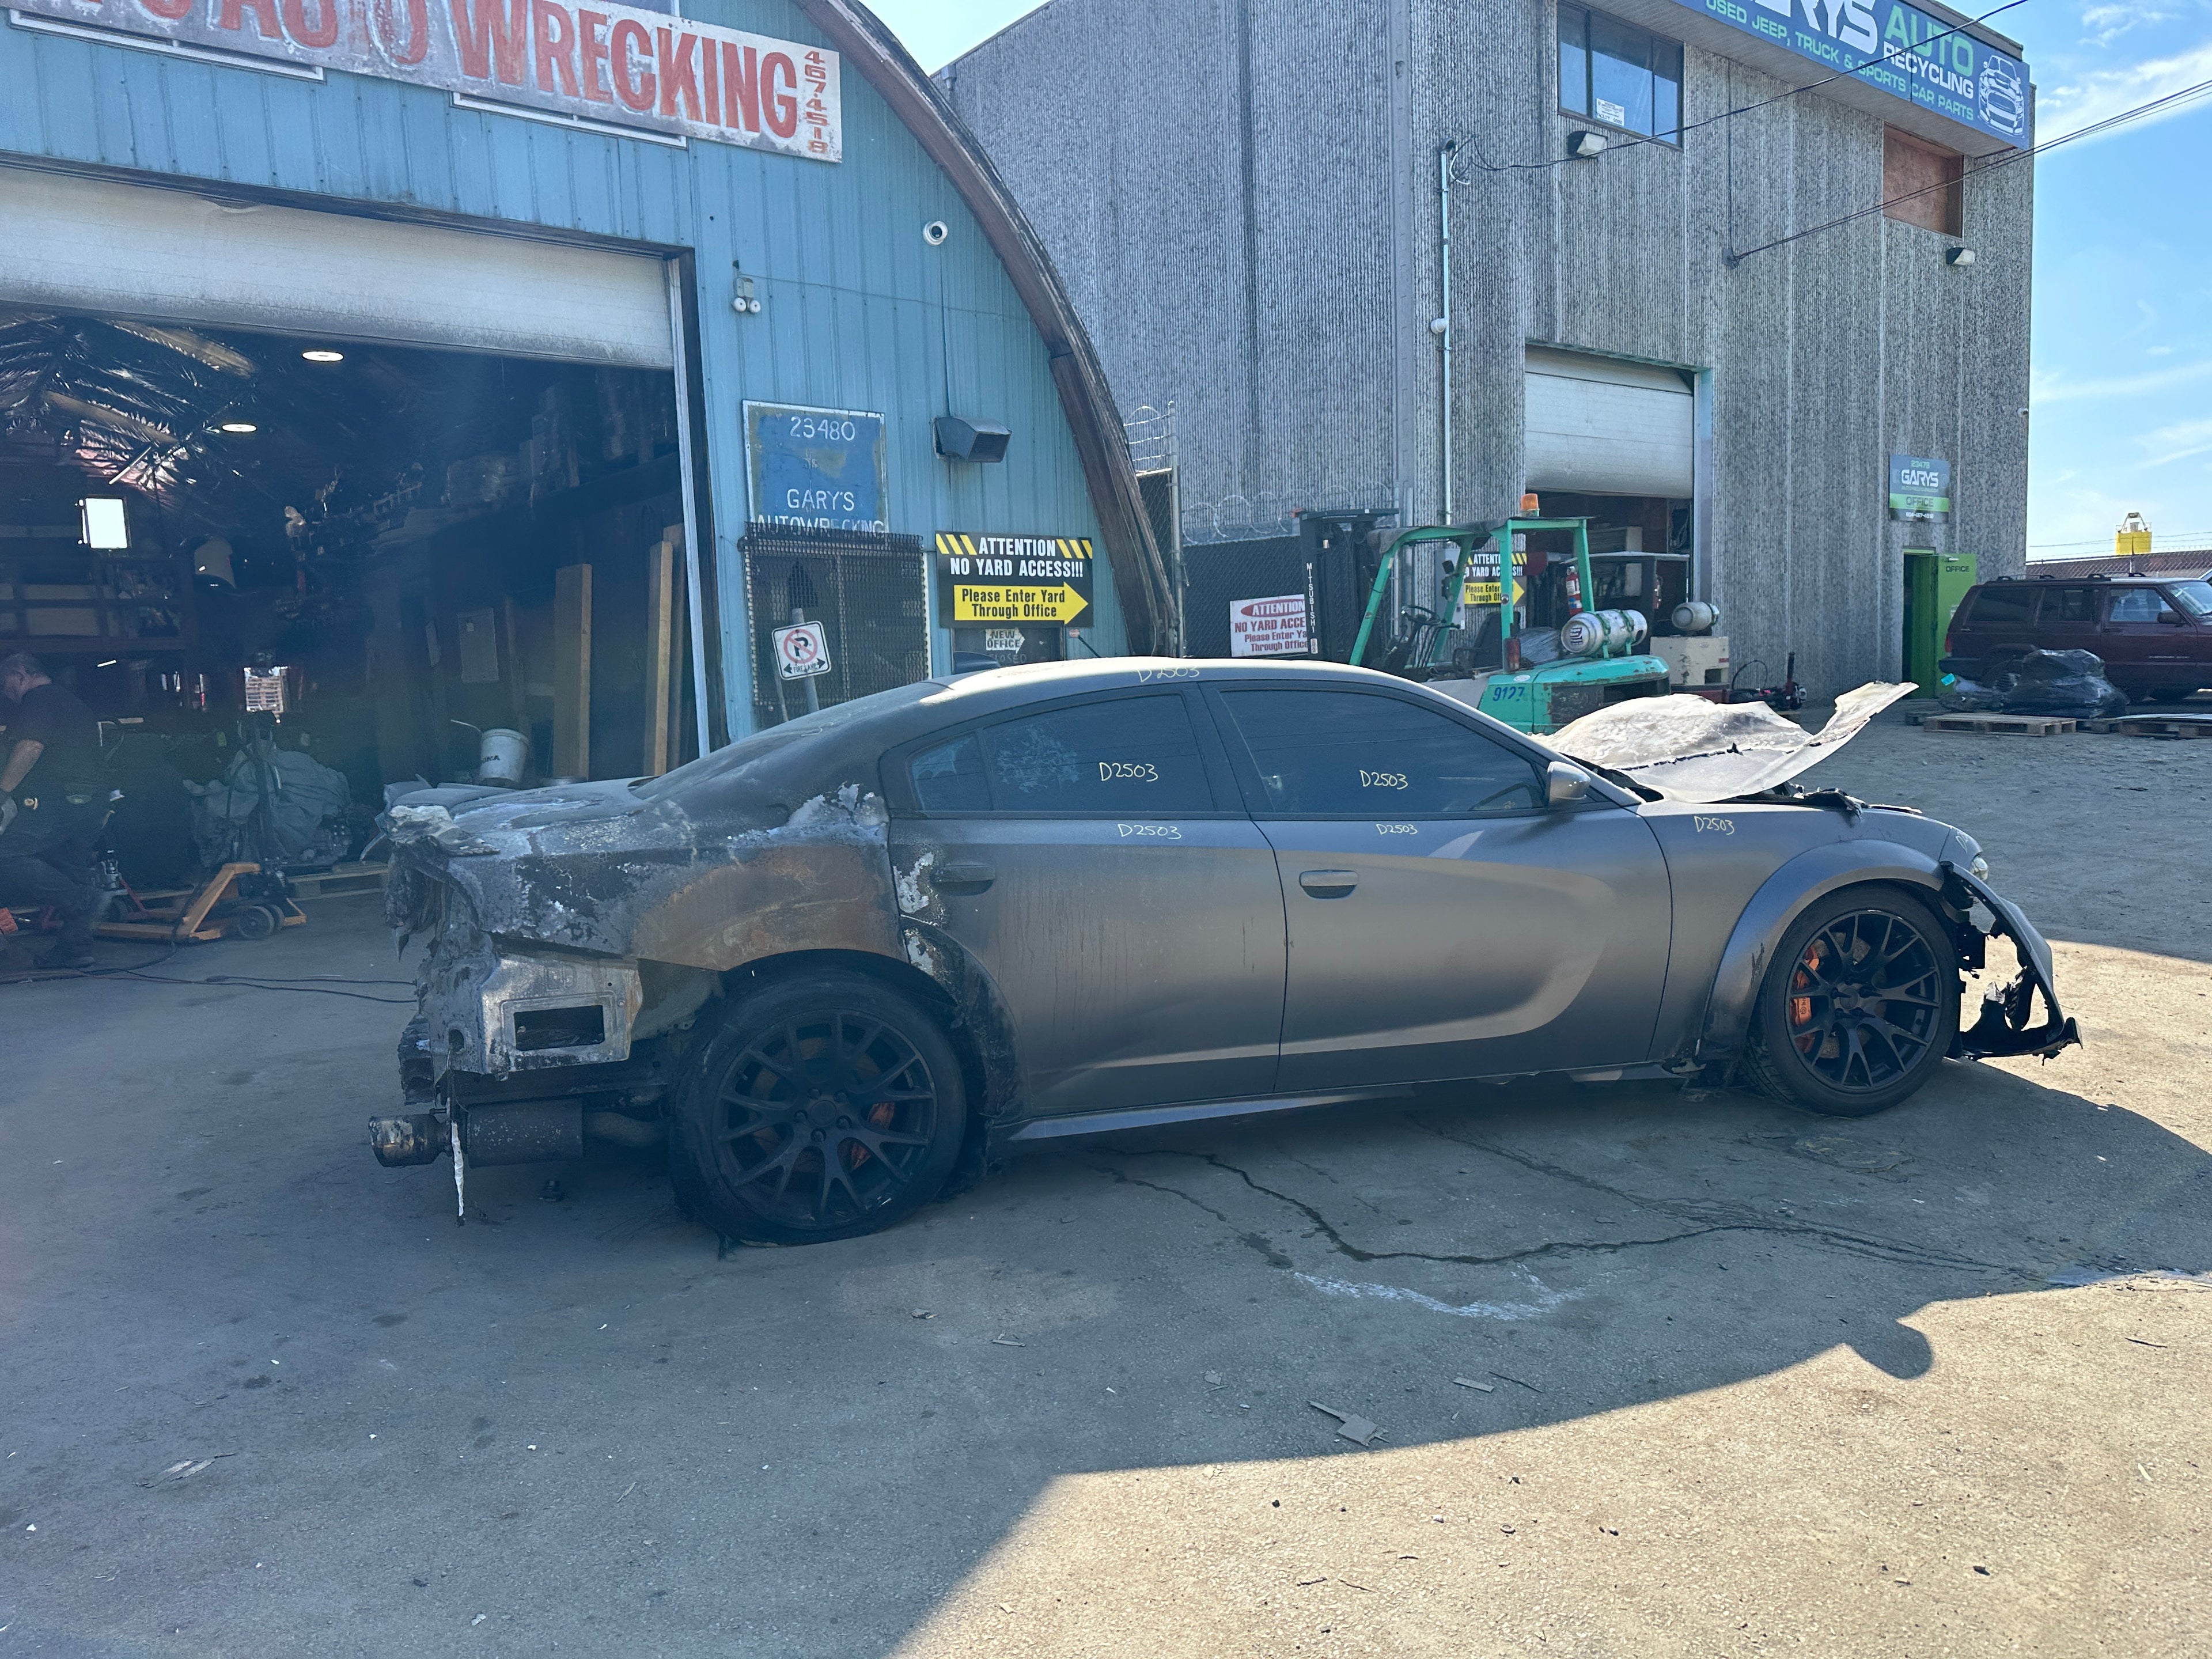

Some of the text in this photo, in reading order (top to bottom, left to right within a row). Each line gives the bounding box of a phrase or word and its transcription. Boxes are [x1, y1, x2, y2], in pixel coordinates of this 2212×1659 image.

[1884, 5, 1974, 77] AUTO
[1706, 0, 1974, 120] USED JEEP, TRUCK & SPORTS CAR PARTS
[450, 0, 798, 138] WRECKING
[1883, 41, 1974, 99] RECYCLING
[790, 415, 856, 441] 23480
[1902, 469, 1939, 487] GARYS
[787, 488, 855, 512] GARY'S
[1906, 496, 1934, 507] OFFICE
[979, 537, 1056, 557] ATTENTION
[950, 558, 1083, 578] NO YARD ACCESS!!!
[1474, 554, 1501, 565] ATTENTI
[1472, 566, 1490, 577] YARD
[962, 588, 1065, 603] Please Enter Yard
[1465, 584, 1500, 594] Please Enter
[1306, 563, 1316, 633] MITSUBISHI
[1469, 594, 1492, 603] Through
[972, 604, 1057, 619] Through Office
[1252, 600, 1305, 616] ATTENTION
[1234, 616, 1306, 632] NO YARD ACCE
[987, 638, 1021, 647] OFFICE
[991, 630, 1015, 638] NEW
[1244, 630, 1308, 642] Please Enter Ya
[794, 637, 809, 657] P
[1251, 641, 1283, 652] Through
[1137, 665, 1200, 682] D2503
[1099, 762, 1158, 782] D2503
[1359, 770, 1408, 790] D2503
[1118, 823, 1181, 840] D2503
[1376, 824, 1418, 835] D2503
[1694, 815, 1734, 835] D2503
